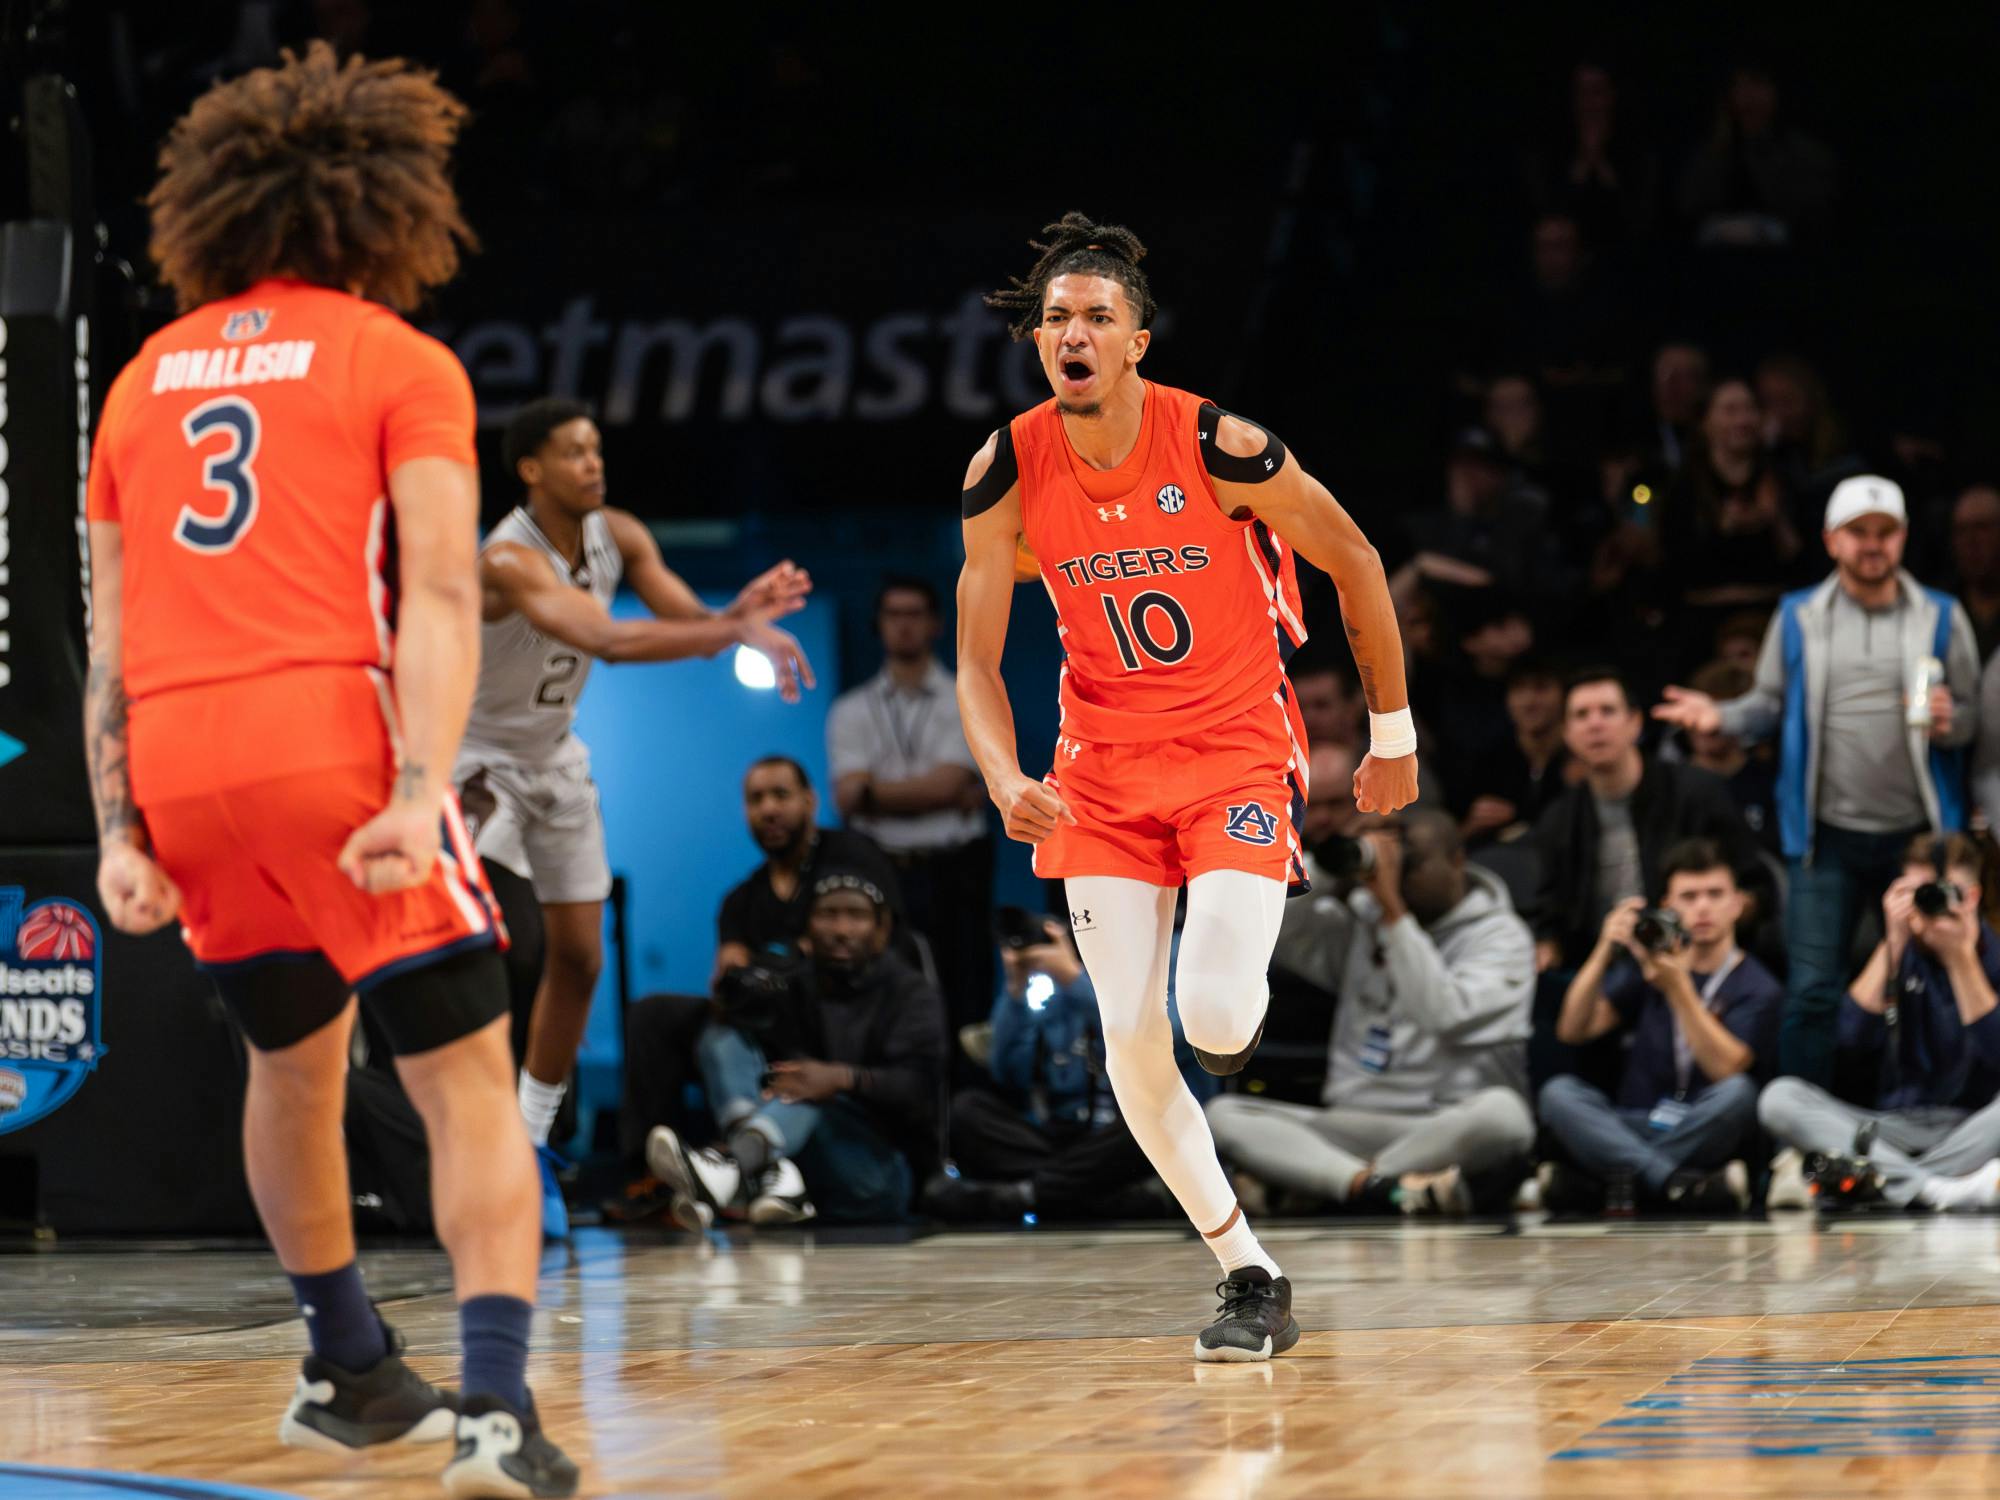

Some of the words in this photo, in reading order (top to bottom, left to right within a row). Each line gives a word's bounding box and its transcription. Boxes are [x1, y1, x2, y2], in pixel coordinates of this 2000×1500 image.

[152, 341, 315, 394] DONALDSON
[173, 395, 261, 555] 3
[1157, 484, 1185, 514] SEC
[1056, 544, 1210, 587] TIGERS
[1100, 590, 1193, 672] 10
[531, 651, 581, 710] 2
[0, 998, 86, 1044] NDS
